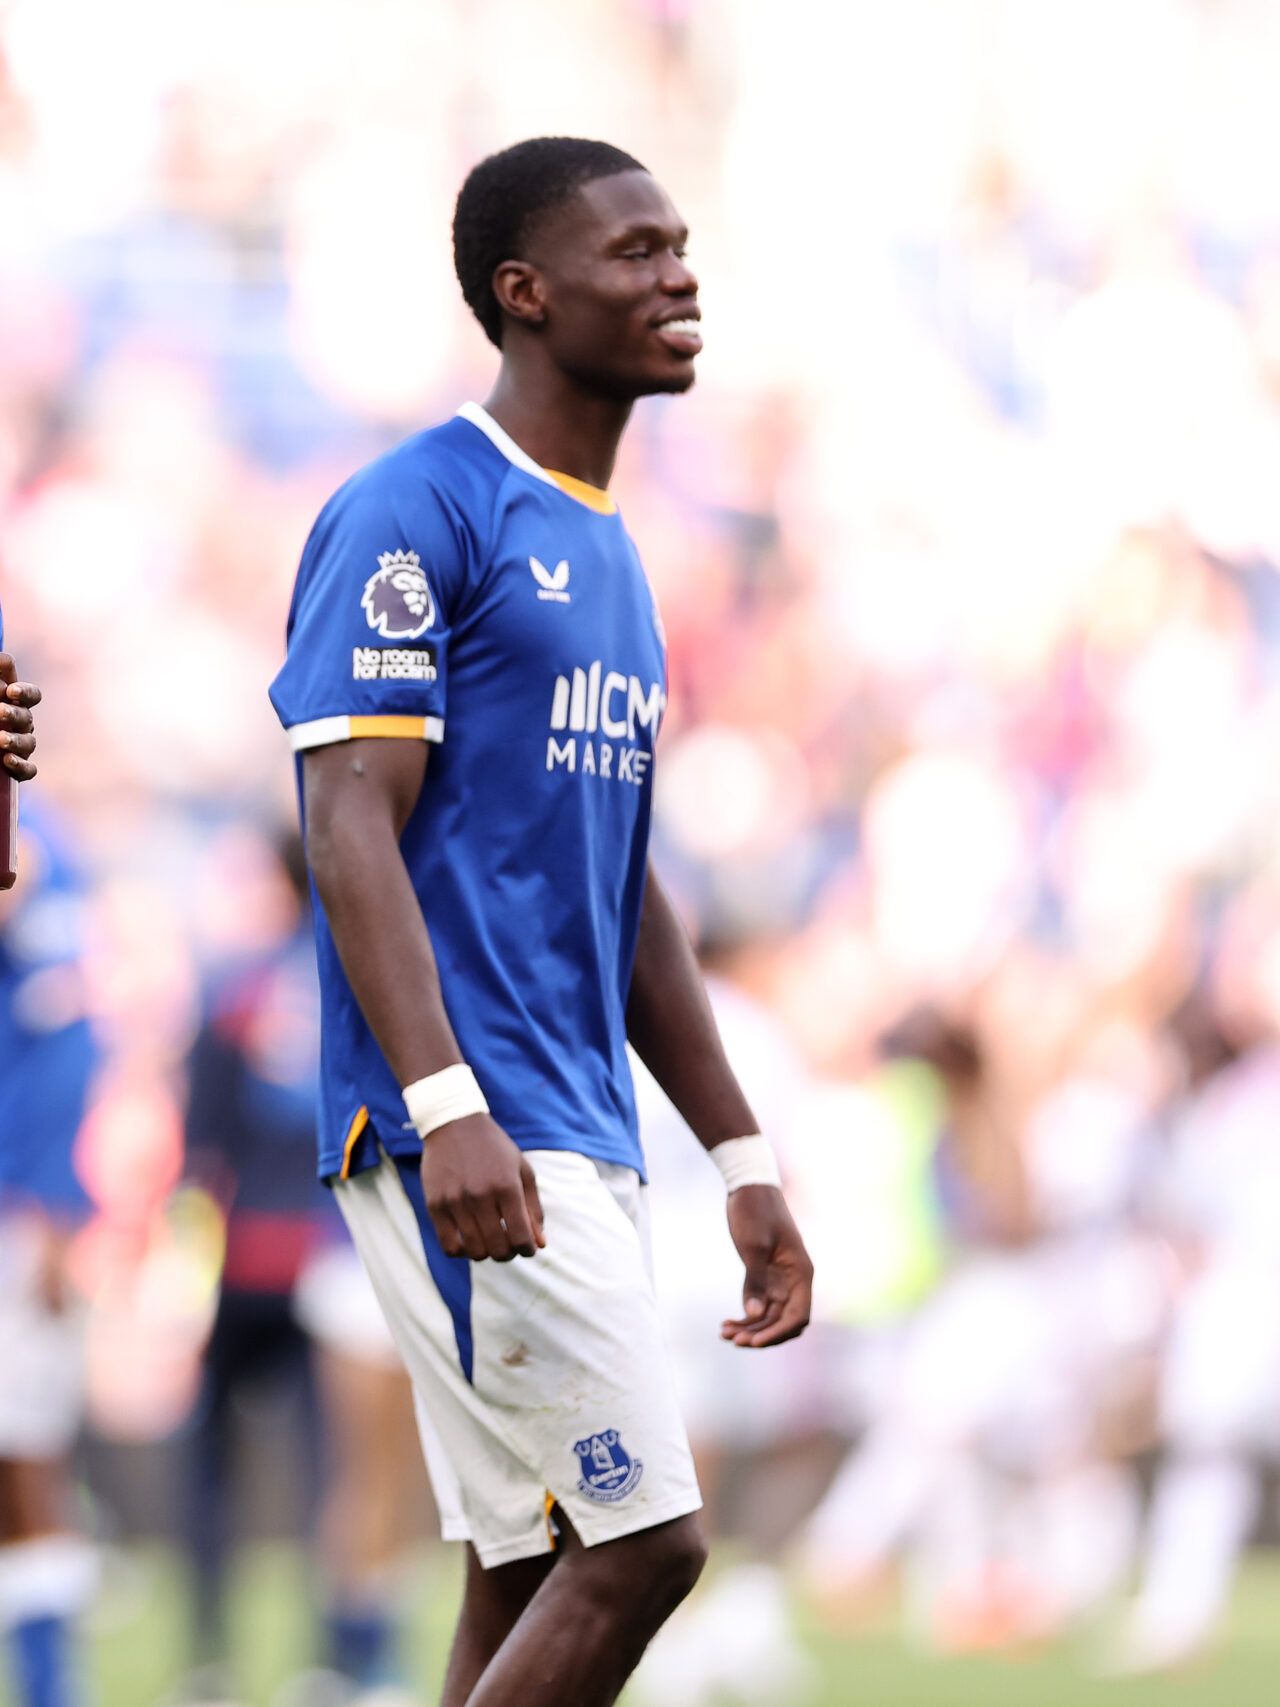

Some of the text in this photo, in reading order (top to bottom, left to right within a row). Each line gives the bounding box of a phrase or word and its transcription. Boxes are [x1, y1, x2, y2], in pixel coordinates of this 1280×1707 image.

[353, 647, 430, 665] No room
[353, 663, 437, 681] for racism
